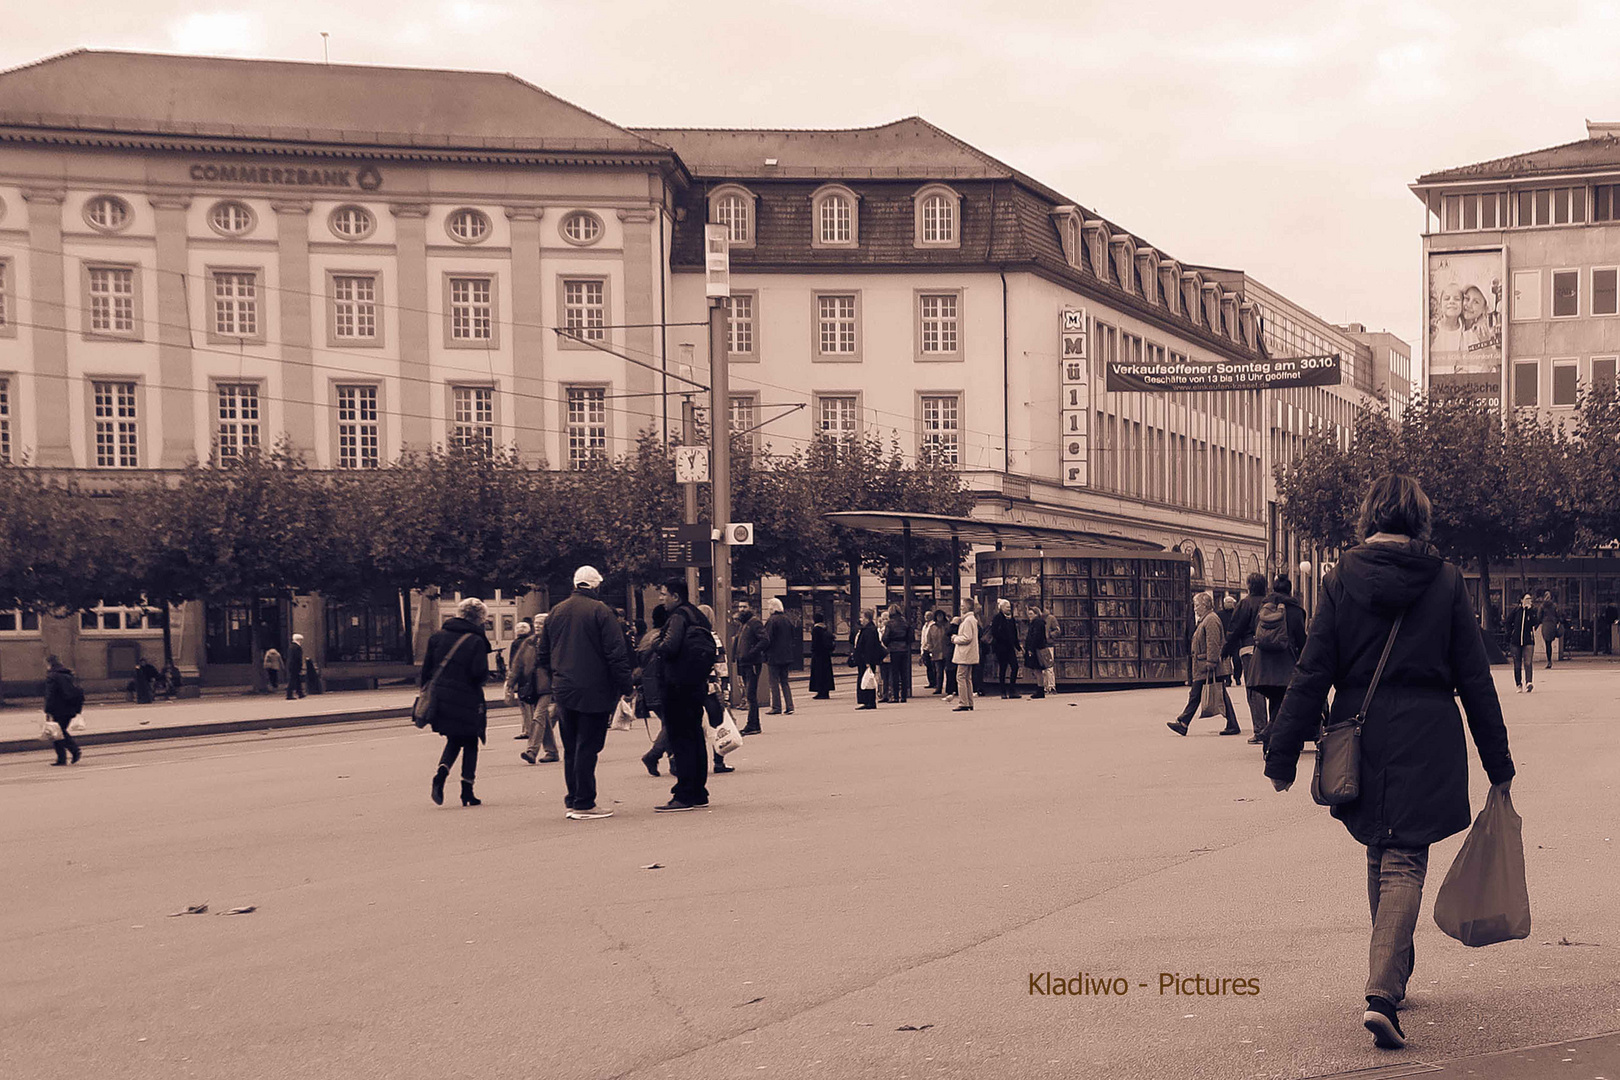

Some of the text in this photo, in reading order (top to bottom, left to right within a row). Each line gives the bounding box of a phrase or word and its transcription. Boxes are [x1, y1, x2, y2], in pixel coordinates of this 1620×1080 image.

[189, 164, 350, 186] COMMERZBANK
[1112, 357, 1336, 374] Verkaufsoffener Sonntag am 30.10.
[1144, 375, 1187, 384] Geschäfte
[1207, 375, 1218, 383] 13
[1220, 374, 1233, 382] bis
[1236, 373, 1246, 382] 18
[1248, 372, 1263, 381] Uhr
[1265, 371, 1301, 382] geöffnet
[1064, 338, 1083, 480] Müller
